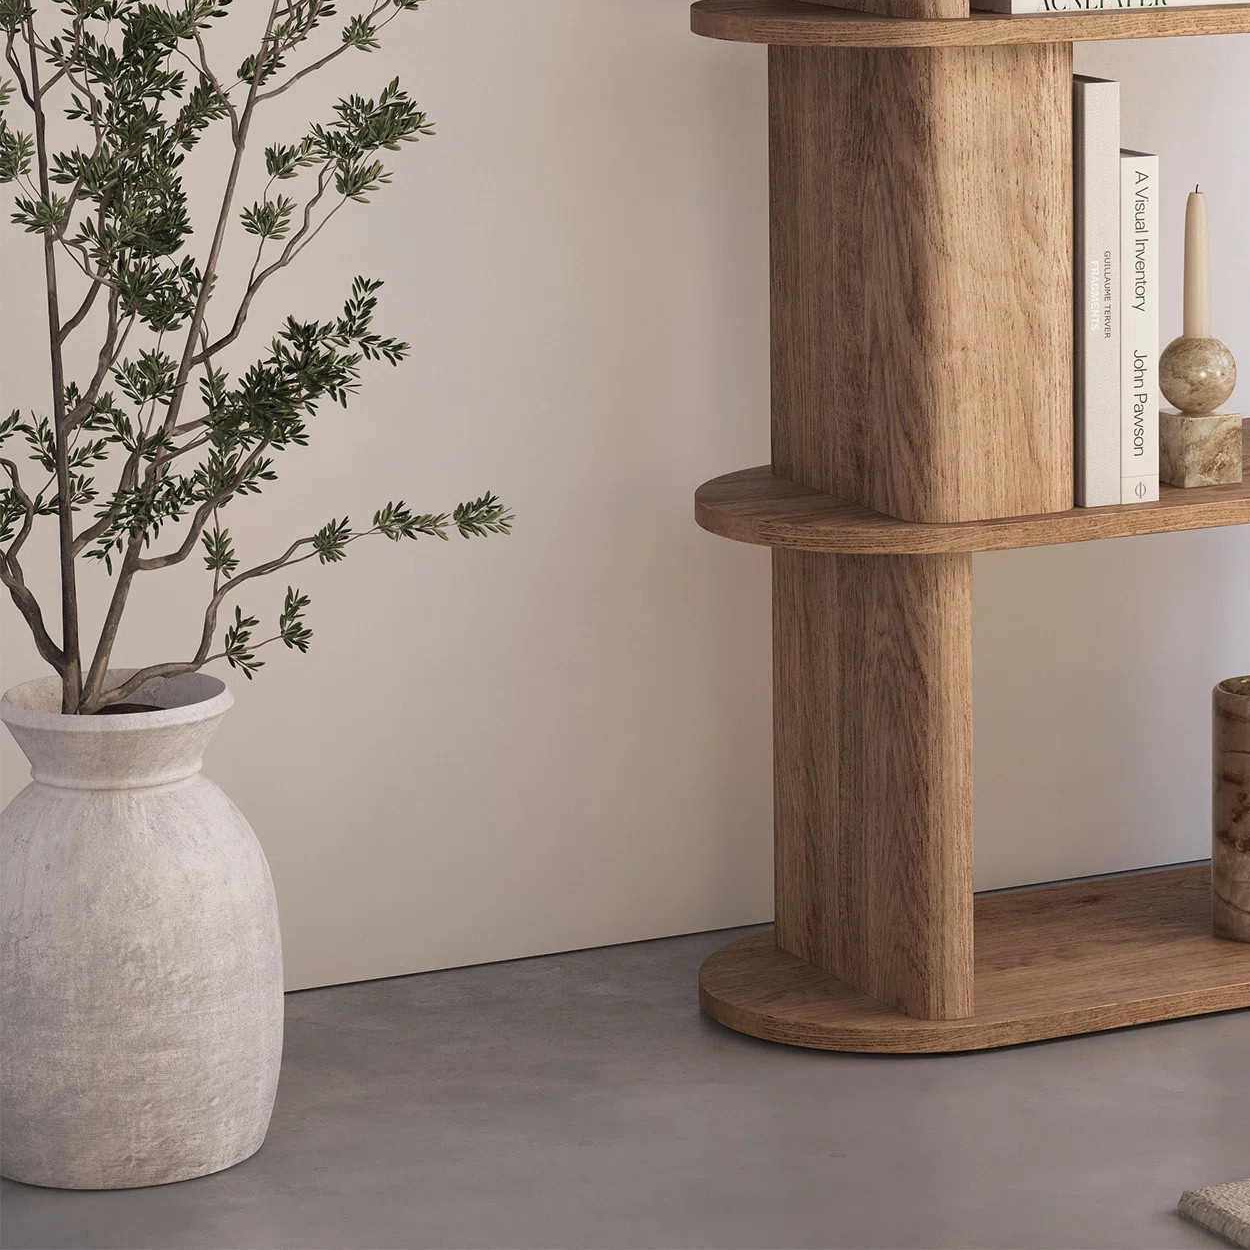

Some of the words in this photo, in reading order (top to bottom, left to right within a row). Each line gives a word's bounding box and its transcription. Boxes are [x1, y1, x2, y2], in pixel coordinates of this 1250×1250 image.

[1135, 170, 1149, 185] A
[1135, 186, 1149, 234] Visual
[1090, 260, 1100, 331] FRAGMENTS
[1103, 250, 1111, 302] GUILLAUME
[1132, 238, 1149, 312] Inventory
[1104, 304, 1112, 339] TERVER
[1133, 350, 1148, 389] John
[1133, 393, 1148, 457] Pawson
